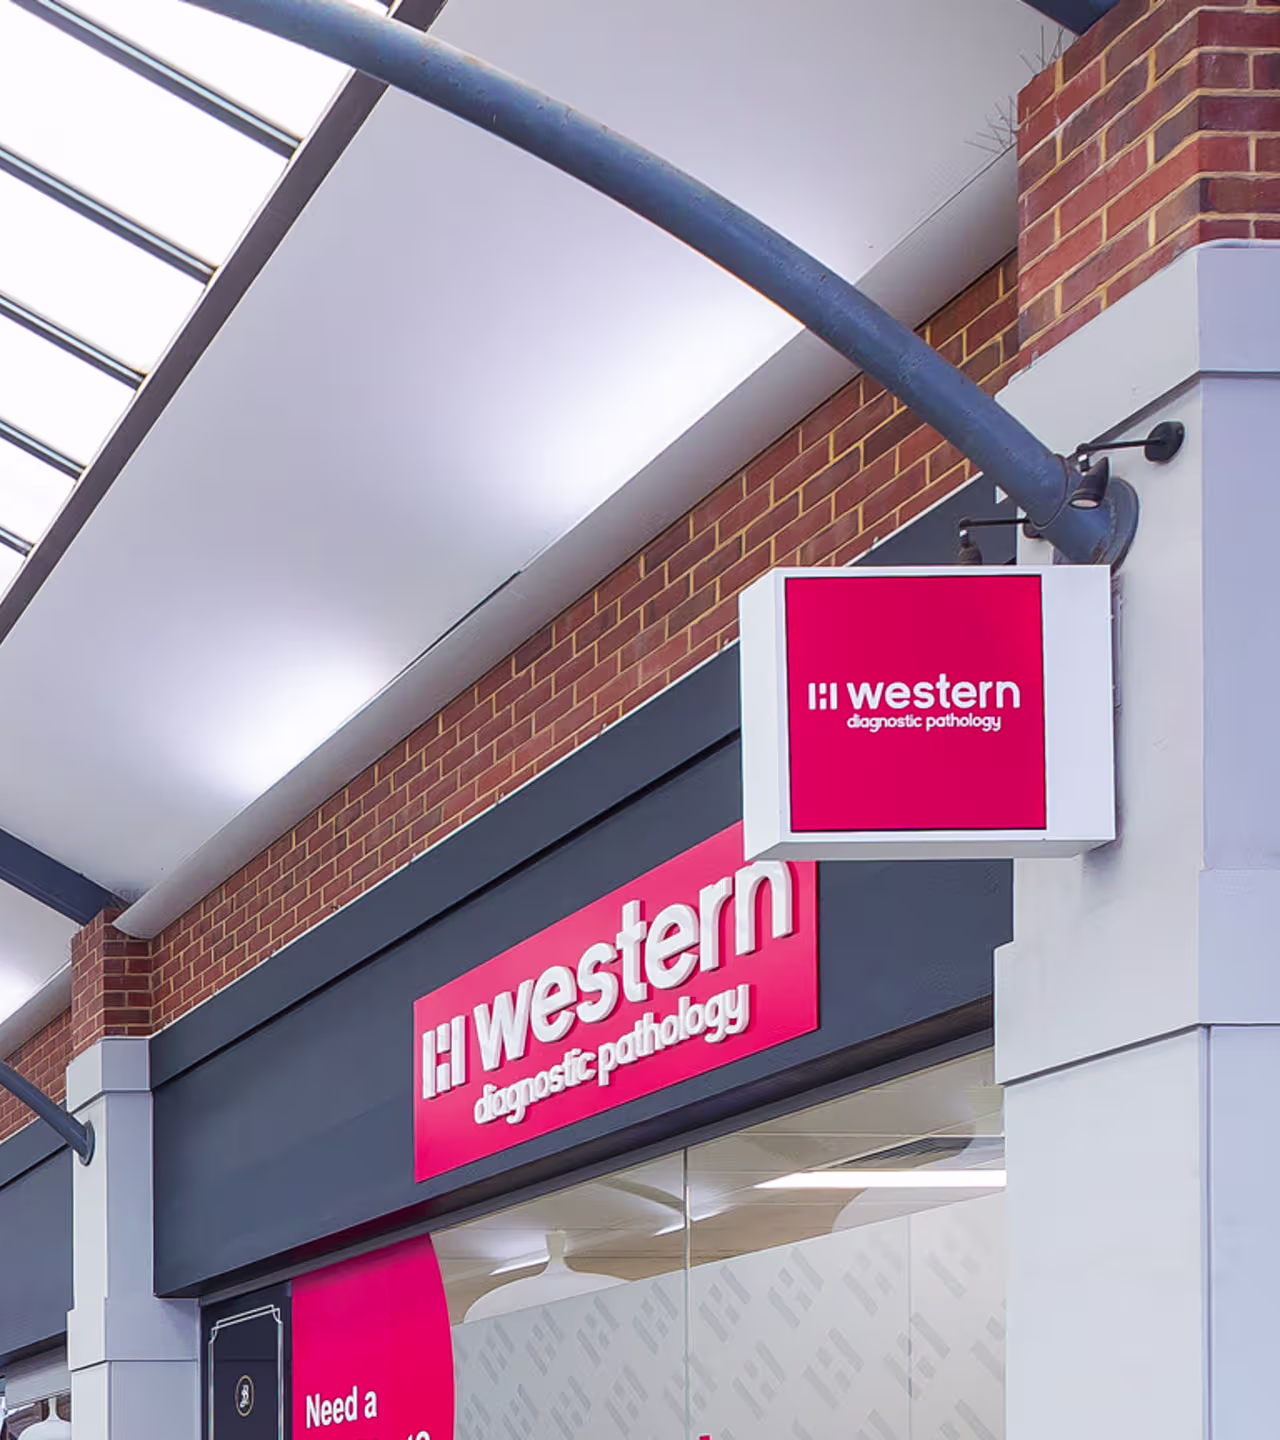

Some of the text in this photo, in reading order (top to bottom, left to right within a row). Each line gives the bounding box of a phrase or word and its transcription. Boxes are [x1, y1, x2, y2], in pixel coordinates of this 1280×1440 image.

[846, 673, 1021, 710] western
[847, 712, 1002, 733] diagnostic pathology
[472, 860, 793, 1072] western
[473, 984, 751, 1125] diagnostic pathology
[305, 1385, 378, 1429] Need a
